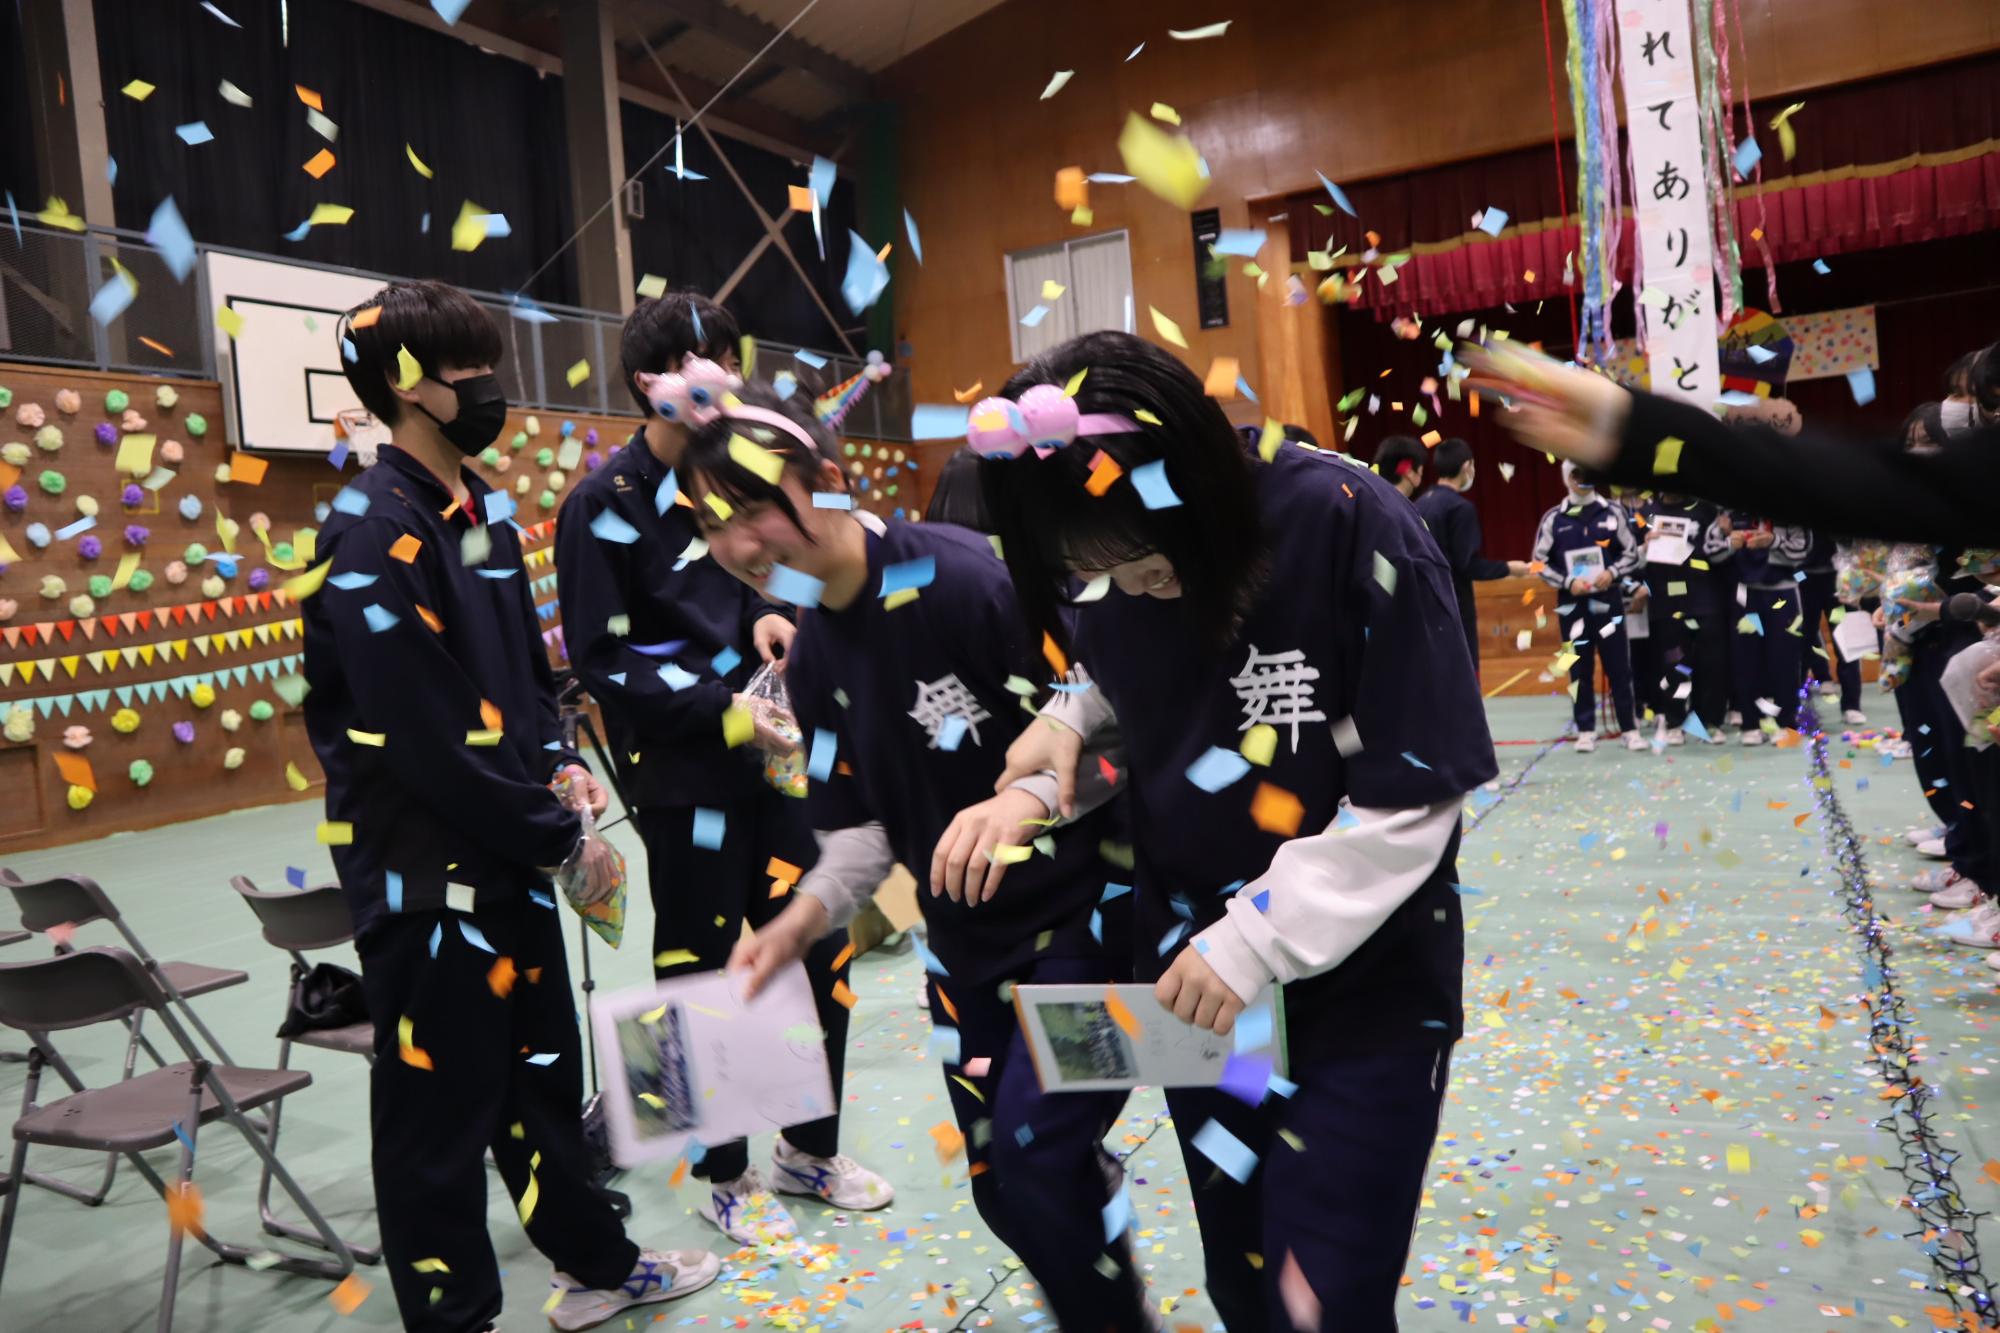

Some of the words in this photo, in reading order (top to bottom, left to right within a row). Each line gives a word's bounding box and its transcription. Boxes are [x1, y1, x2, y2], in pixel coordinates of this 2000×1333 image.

[1641, 0, 1700, 391] れてありがと
[906, 672, 993, 750] 舞
[1228, 643, 1327, 755] 舞
